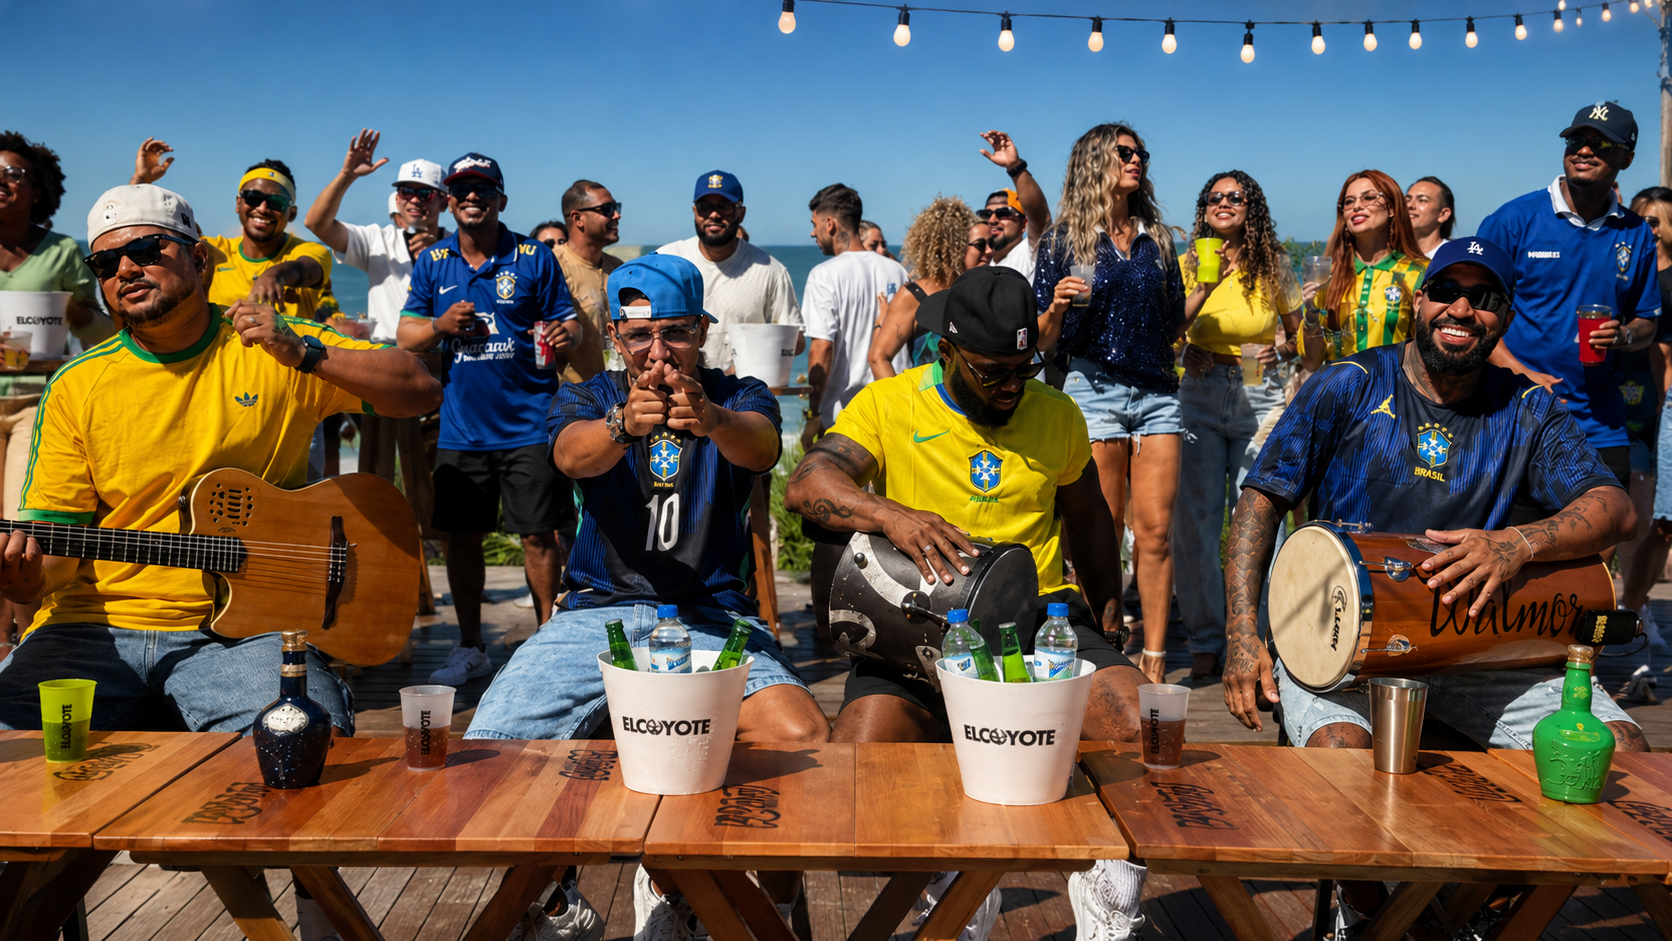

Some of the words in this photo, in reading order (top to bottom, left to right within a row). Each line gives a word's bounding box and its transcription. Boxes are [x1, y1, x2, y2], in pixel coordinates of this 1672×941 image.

[411, 164, 423, 178] LA
[1467, 241, 1484, 255] LA
[1414, 466, 1446, 482] BRASIL
[645, 493, 680, 552] 10
[622, 716, 711, 736] ELCOYOTE
[964, 724, 1056, 746] ELCOYOTE
